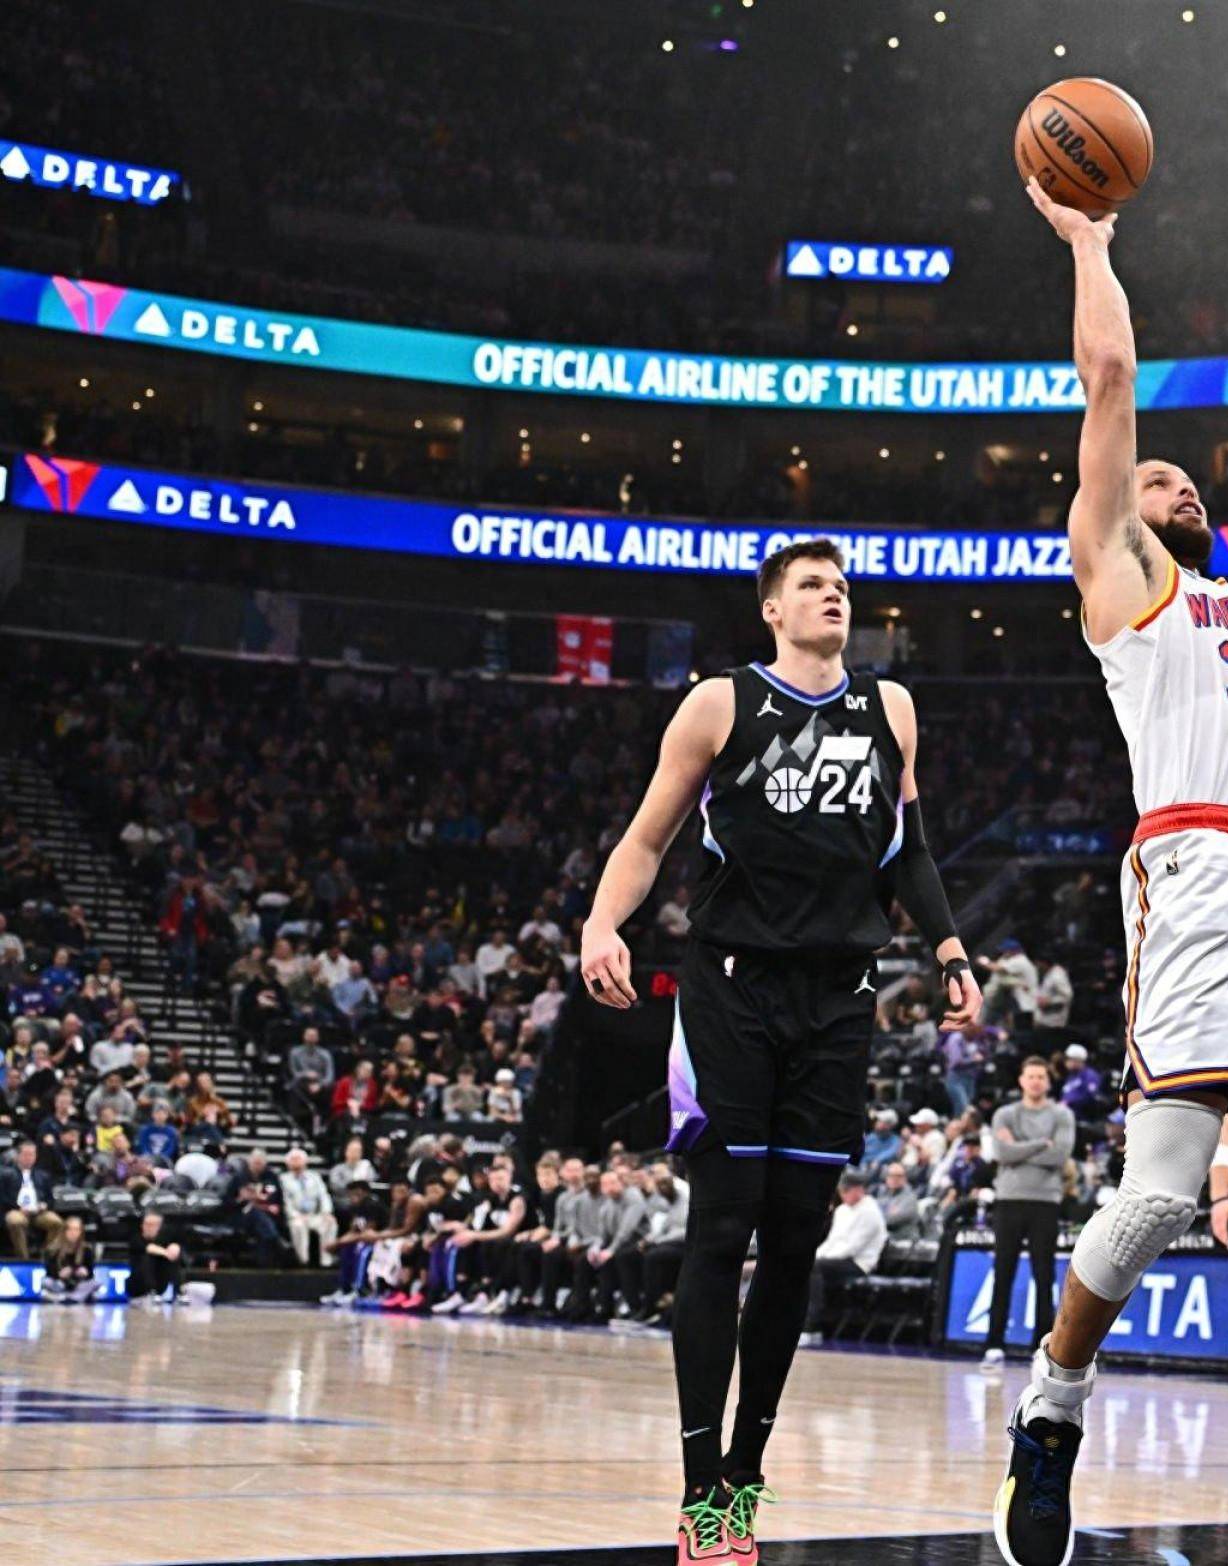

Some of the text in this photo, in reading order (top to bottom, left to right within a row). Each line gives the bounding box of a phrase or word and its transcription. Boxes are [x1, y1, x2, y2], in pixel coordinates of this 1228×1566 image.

[1041, 107, 1109, 189] Wilson
[42, 153, 171, 201] DELTA
[829, 247, 951, 278] DELTA
[180, 309, 320, 356] DELTA
[473, 342, 633, 394] OFFICIAL
[637, 356, 780, 402] AIRLINE
[782, 363, 830, 404] OF
[836, 365, 905, 407] THE
[909, 367, 1005, 408] UTAH
[156, 484, 296, 530] DELTA
[451, 513, 613, 563] OFFICIAL
[617, 525, 760, 571] AIRLINE
[893, 536, 988, 576] UTAH
[818, 763, 873, 815] 24
